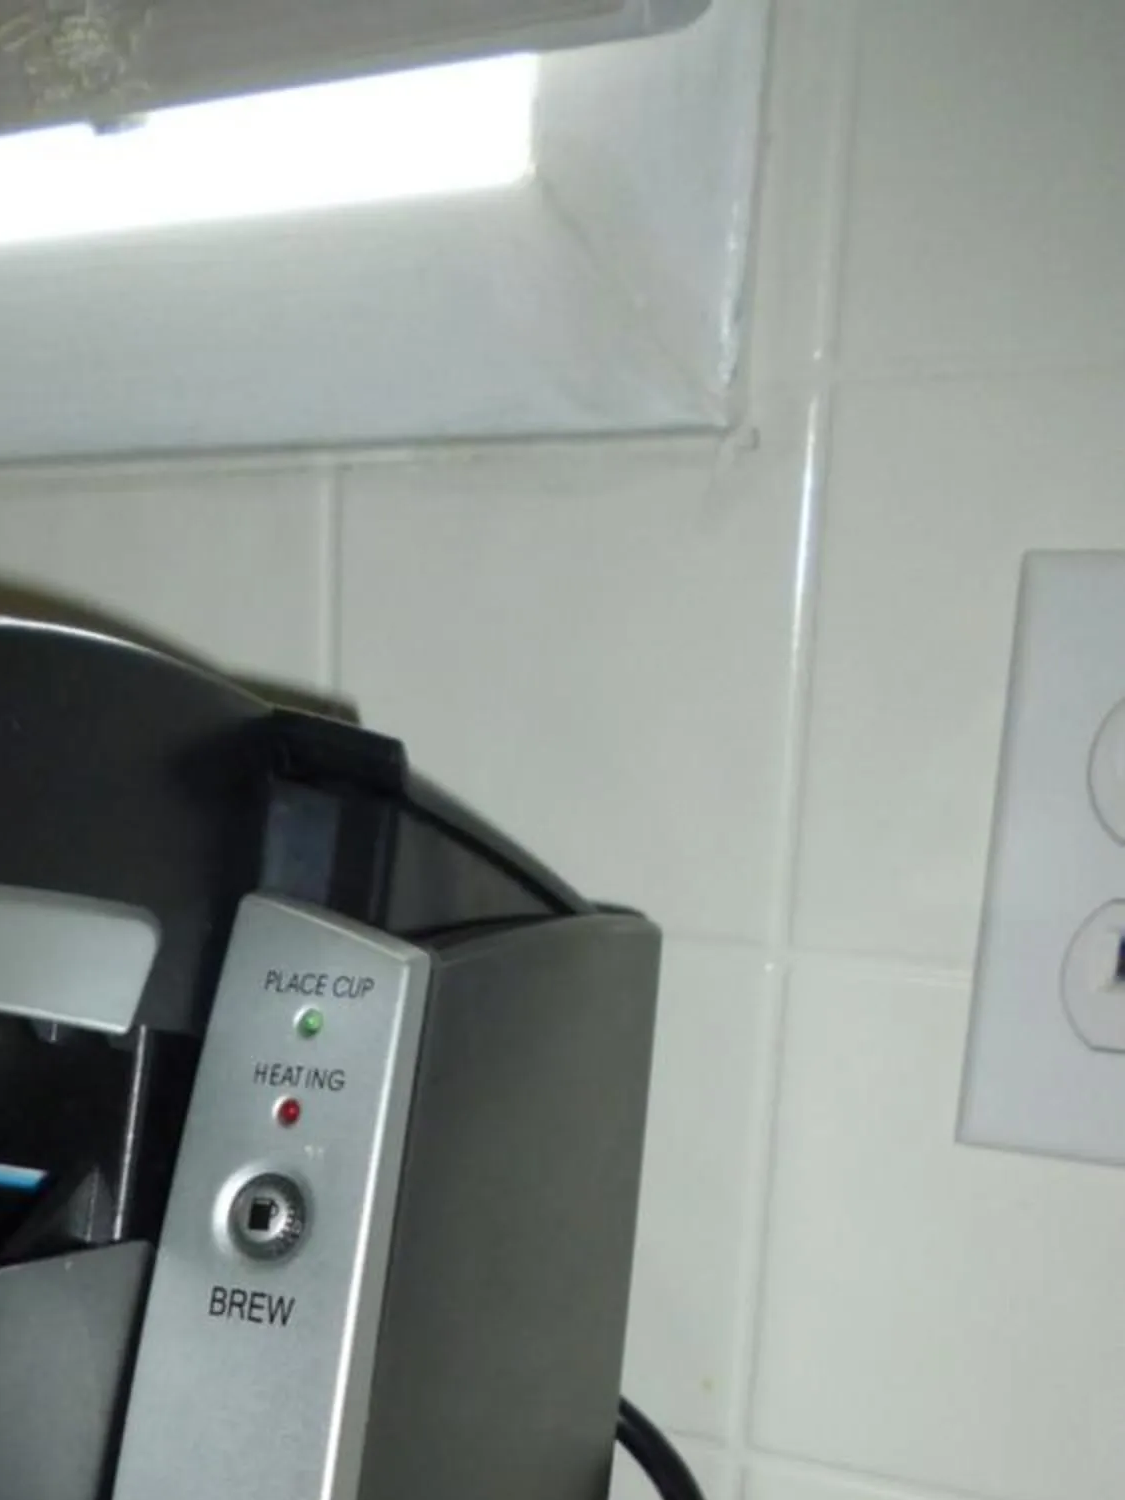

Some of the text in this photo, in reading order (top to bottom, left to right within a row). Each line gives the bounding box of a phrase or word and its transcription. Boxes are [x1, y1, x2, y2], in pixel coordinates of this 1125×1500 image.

[264, 969, 375, 998] PLACE CUP
[253, 1062, 346, 1092] HEATING
[208, 1285, 296, 1326] BREW
